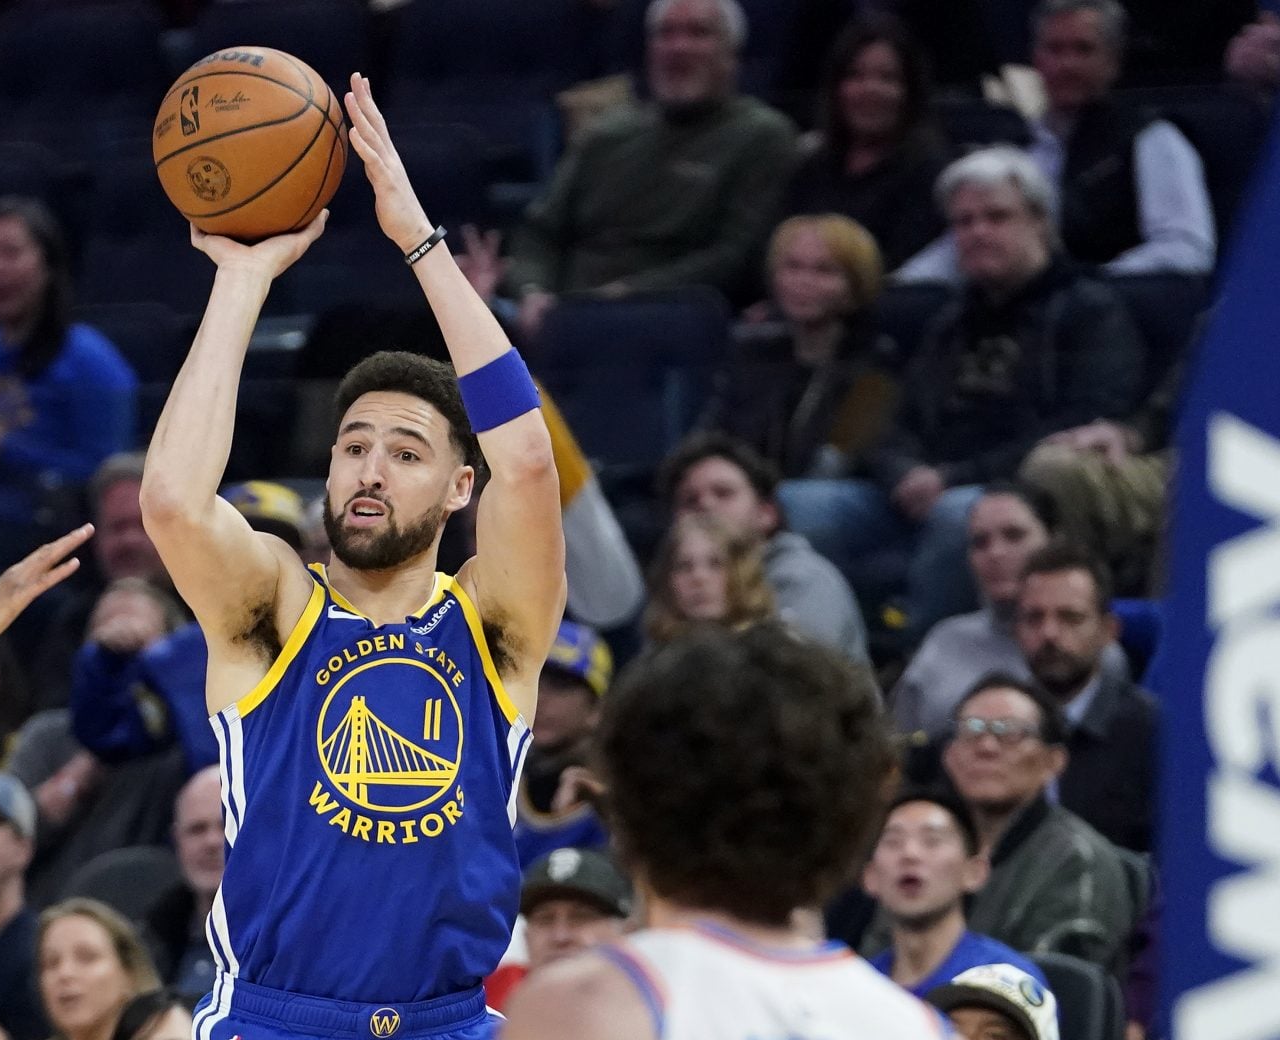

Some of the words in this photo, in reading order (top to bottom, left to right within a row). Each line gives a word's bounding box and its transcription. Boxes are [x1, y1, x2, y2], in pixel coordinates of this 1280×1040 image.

[316, 633, 404, 685] GOLDEN
[415, 642, 465, 687] STATE
[423, 698, 442, 740] 11
[308, 781, 464, 844] WARRIORS
